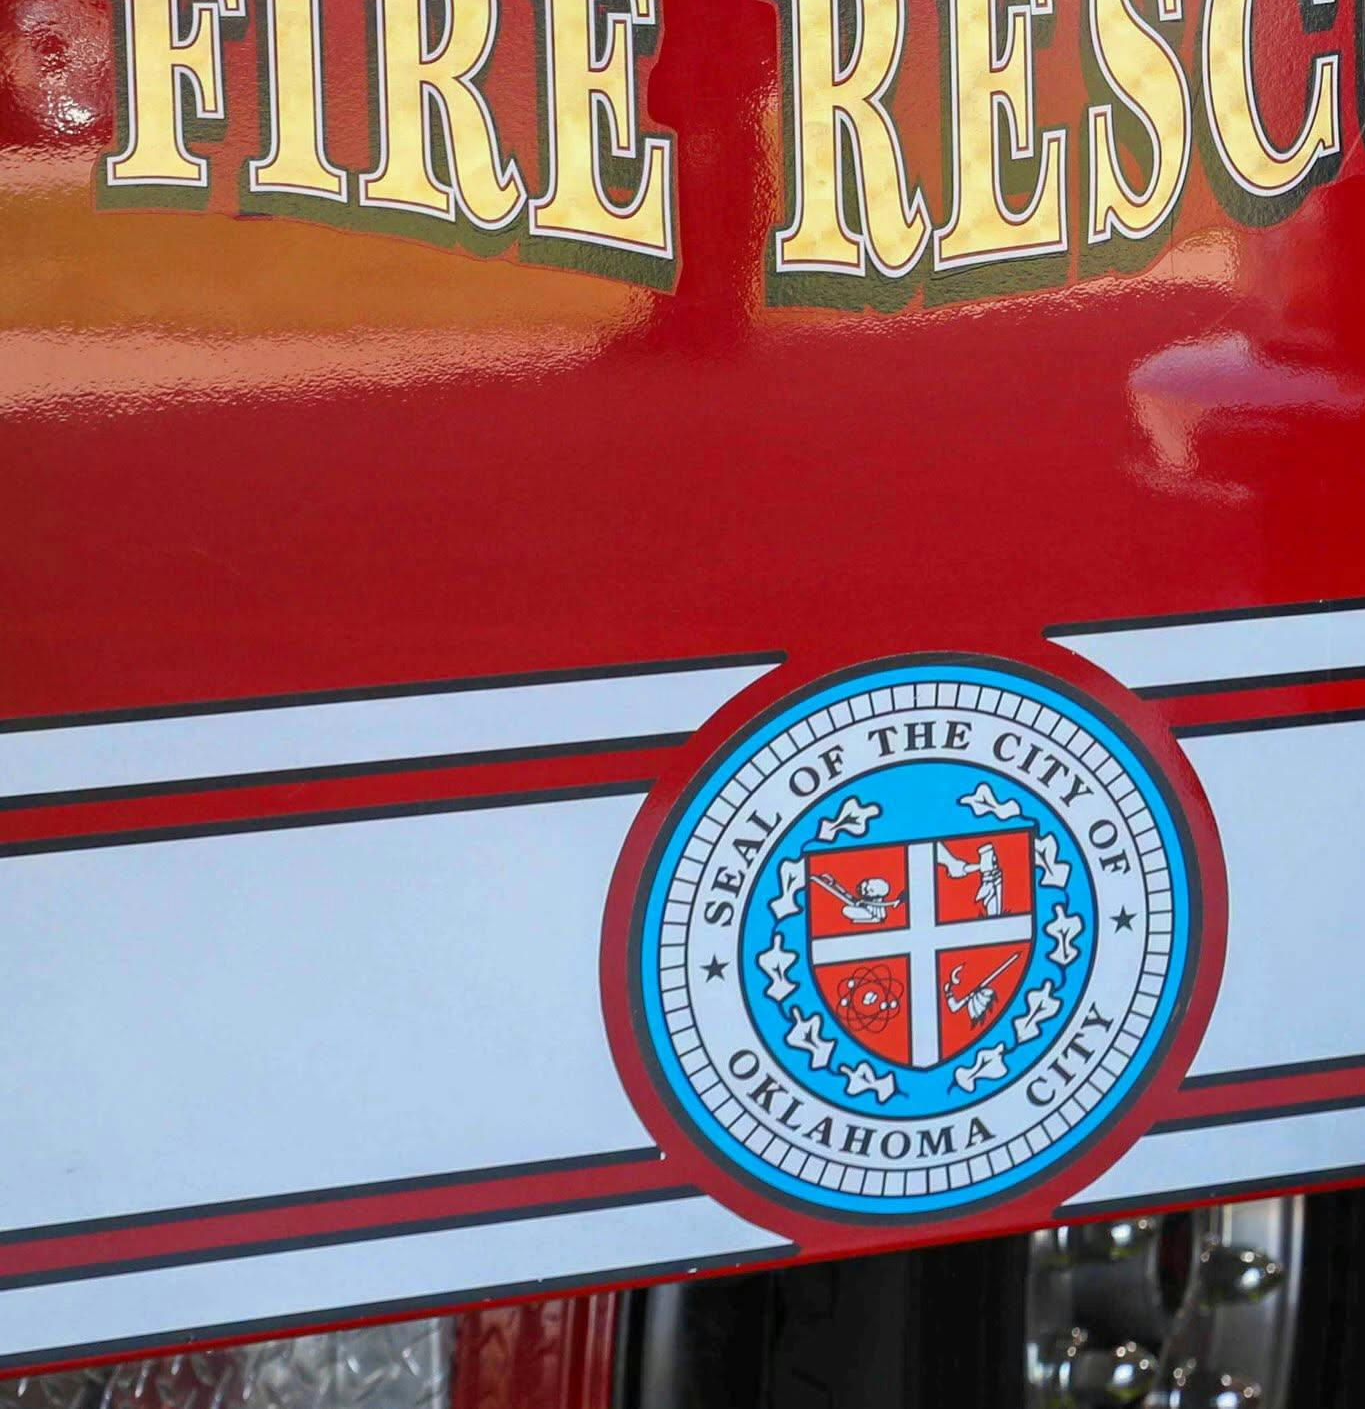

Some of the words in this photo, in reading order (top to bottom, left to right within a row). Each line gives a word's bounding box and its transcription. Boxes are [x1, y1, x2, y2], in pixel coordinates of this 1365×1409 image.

[704, 810, 782, 928] SEAL
[788, 745, 845, 797] OF
[868, 720, 973, 757] THE
[992, 732, 1095, 807] CITY
[1088, 818, 1132, 876] OF
[729, 1048, 996, 1160] OKLAHOMA
[1026, 1002, 1114, 1107] CITY
